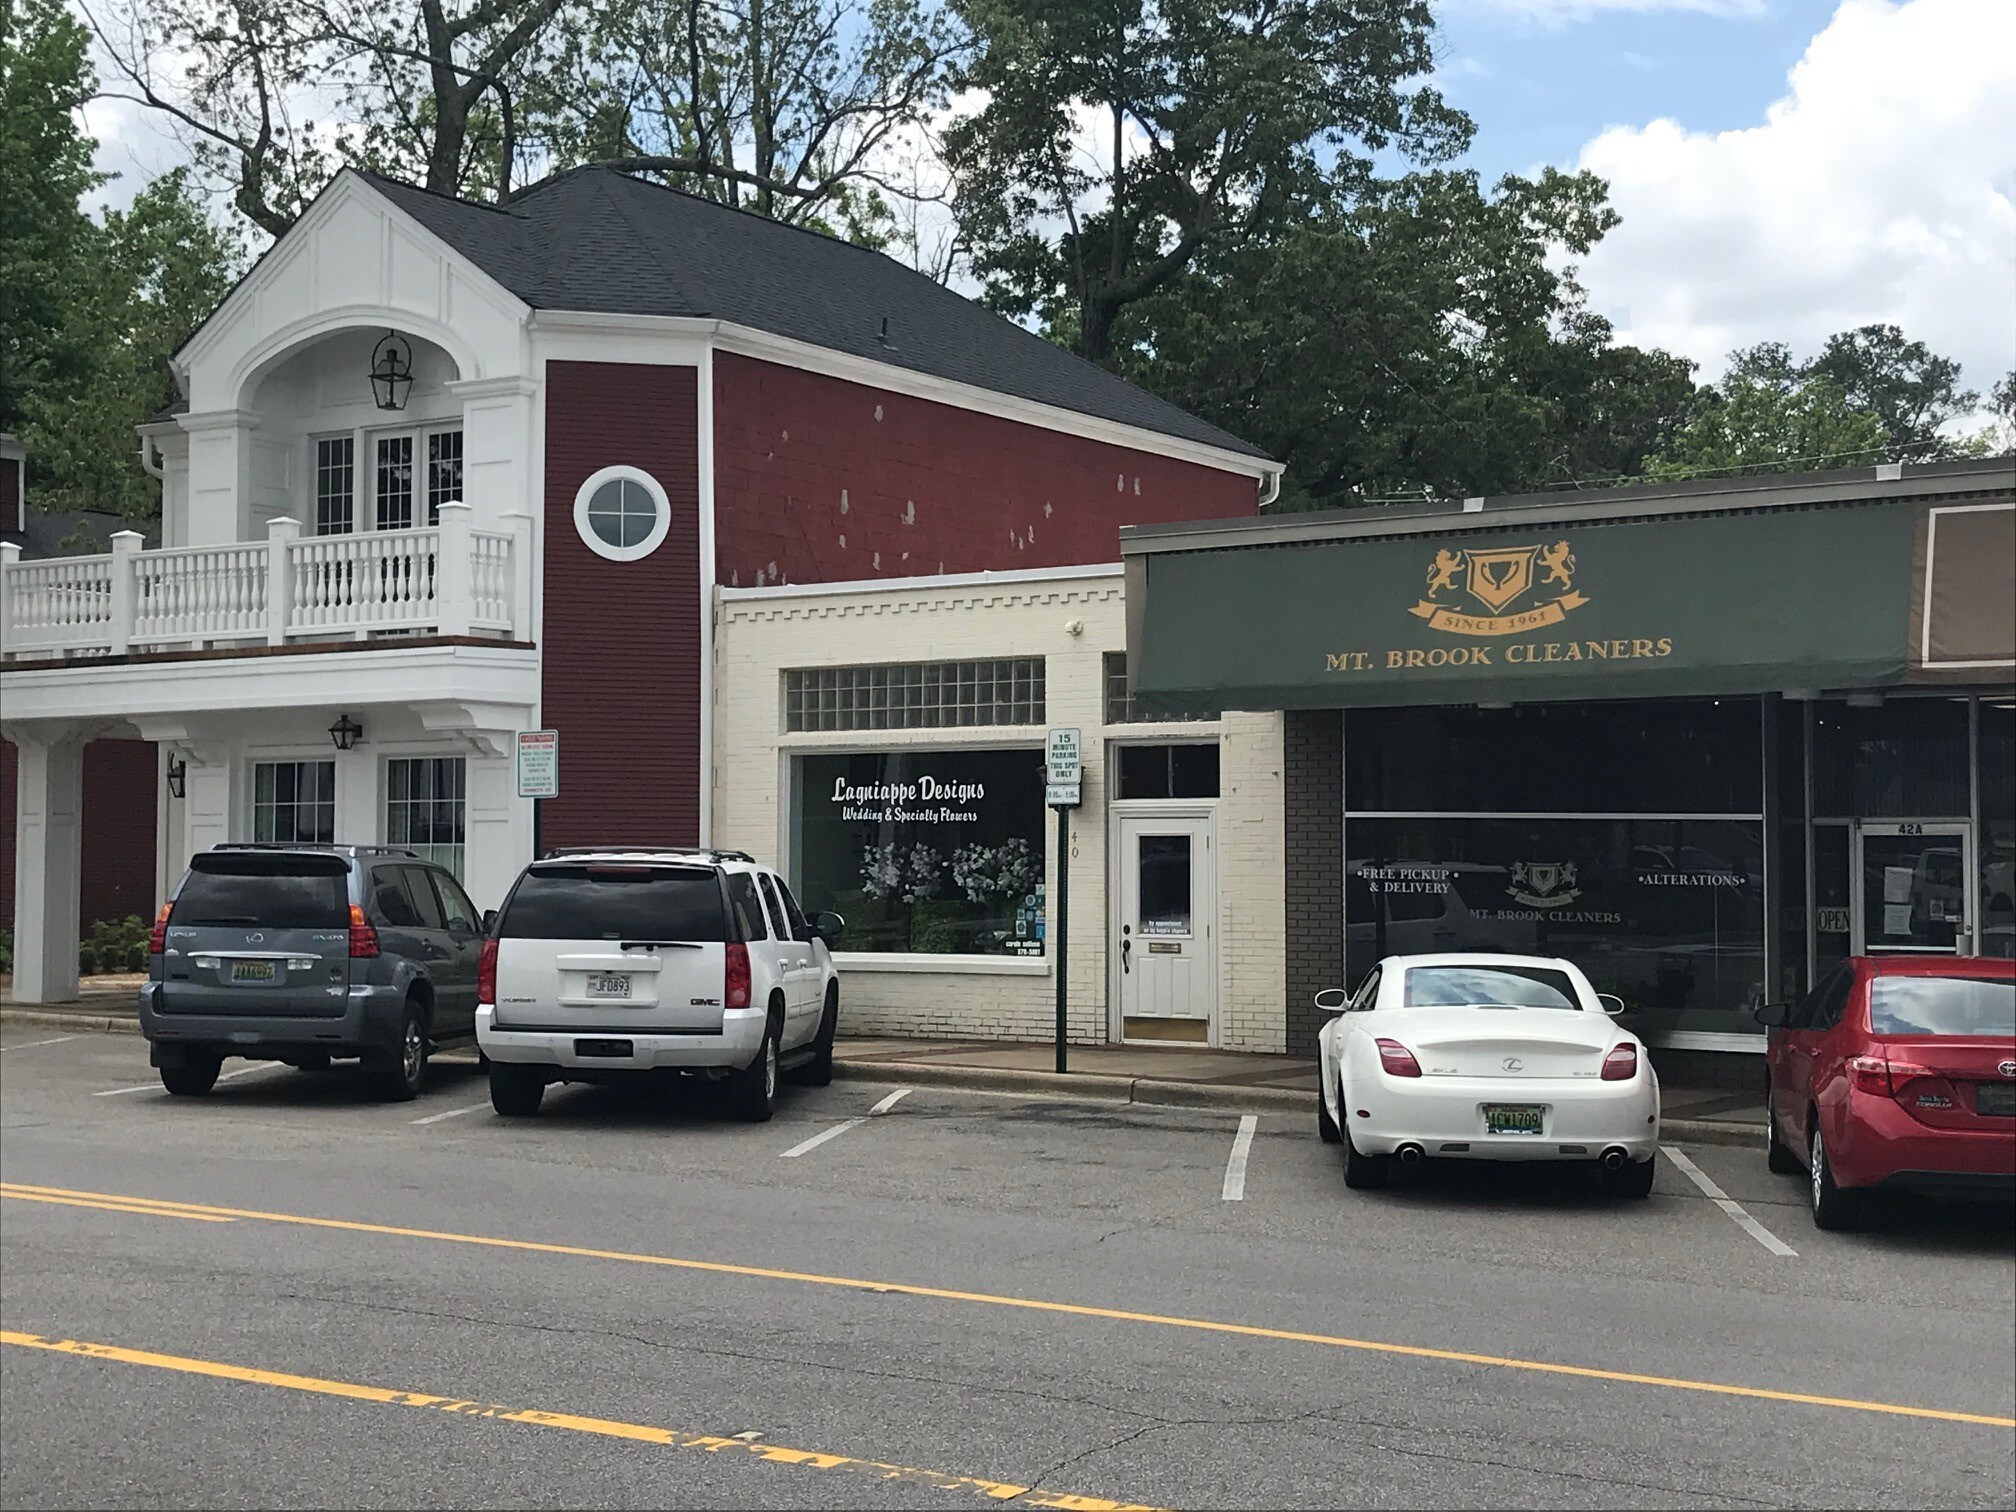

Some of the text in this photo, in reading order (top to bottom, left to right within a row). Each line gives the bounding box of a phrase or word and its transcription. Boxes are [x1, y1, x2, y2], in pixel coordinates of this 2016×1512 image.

[1443, 611, 1547, 631] SINCE 1961
[1325, 636, 1673, 672] MT. BROOK CLEANERS
[1059, 734, 1071, 743] 15
[1064, 761, 1079, 769] SPOT
[831, 775, 985, 805] Lagniappe Designs
[842, 806, 978, 824] Wedding & Specialty Flowers
[1898, 824, 1923, 835] 42A
[1362, 867, 1450, 881] FREE PICKUP
[1643, 873, 1740, 887] ALTERATIONS
[1369, 881, 1451, 894] & DELIVERY
[1469, 908, 1622, 924] MT. BROOK CLEANERS
[1818, 909, 1850, 931] OPEN
[690, 998, 720, 1006] GMC
[1491, 1112, 1539, 1128] 1CW1709
